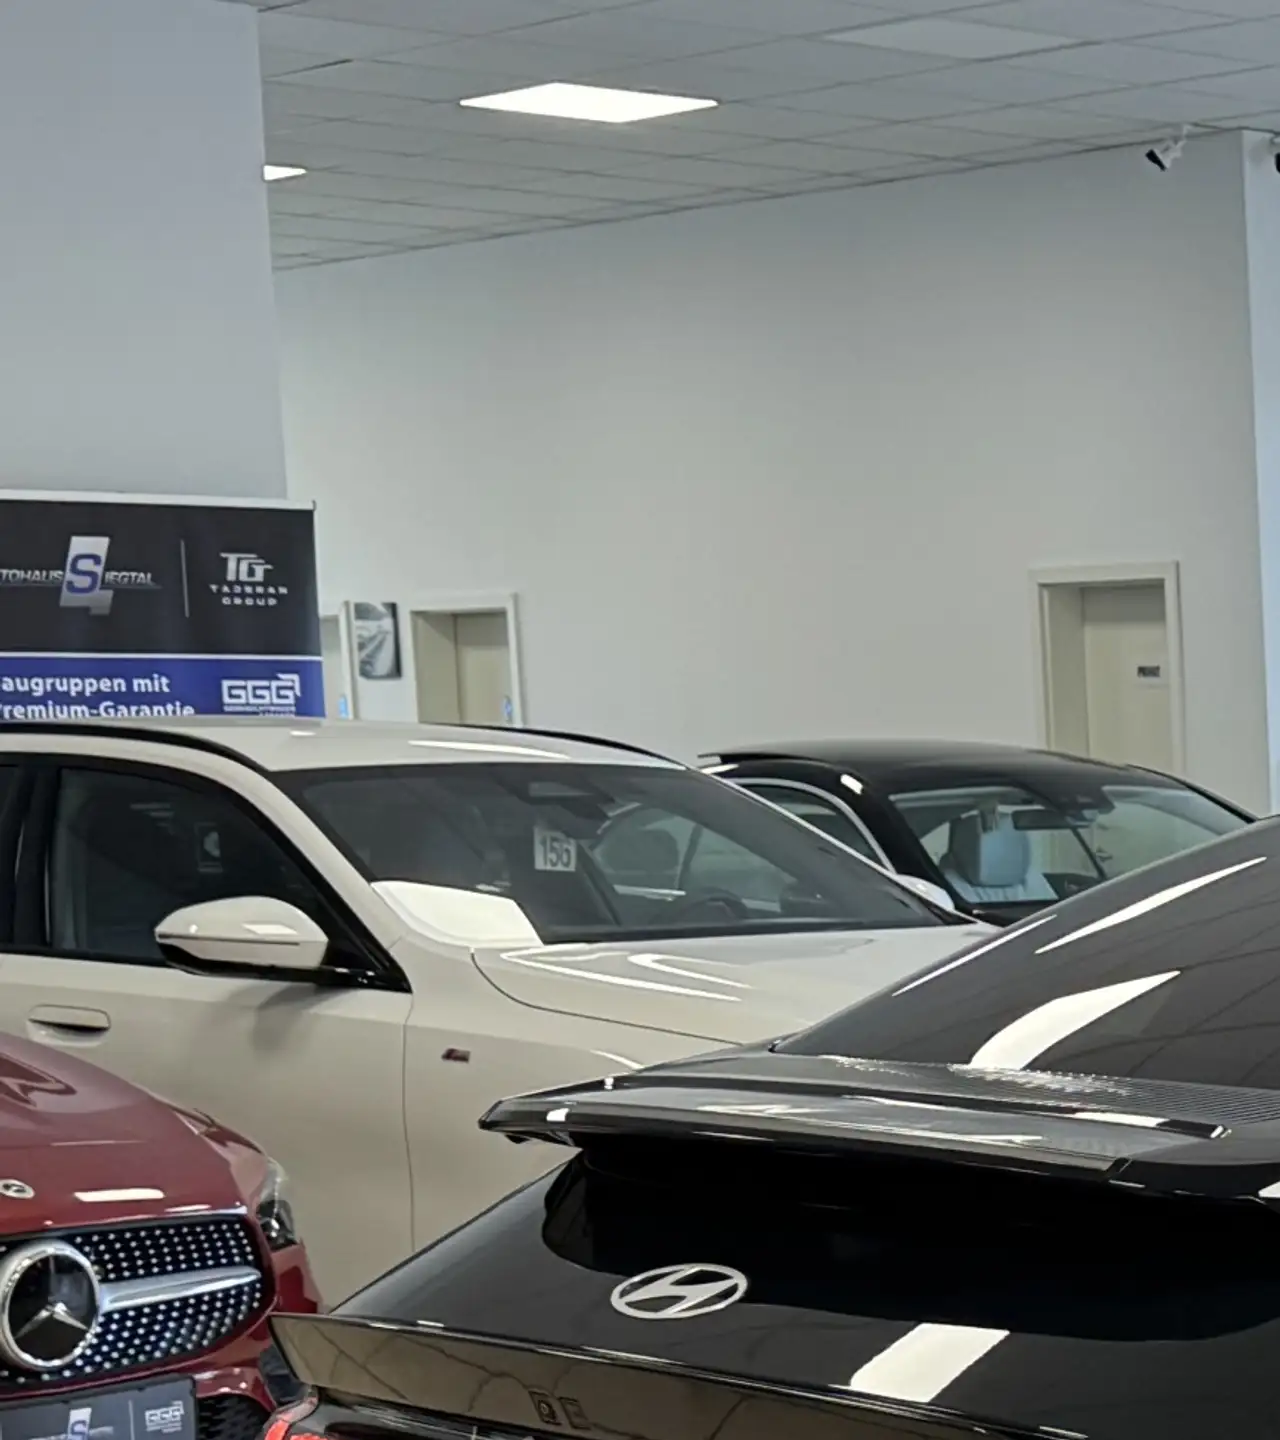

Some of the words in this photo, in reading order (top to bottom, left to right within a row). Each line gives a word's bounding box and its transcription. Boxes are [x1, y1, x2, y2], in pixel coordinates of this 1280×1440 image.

[2, 676, 126, 697] augruppen
[132, 674, 170, 693] mit
[0, 700, 195, 718] remium-Garantie
